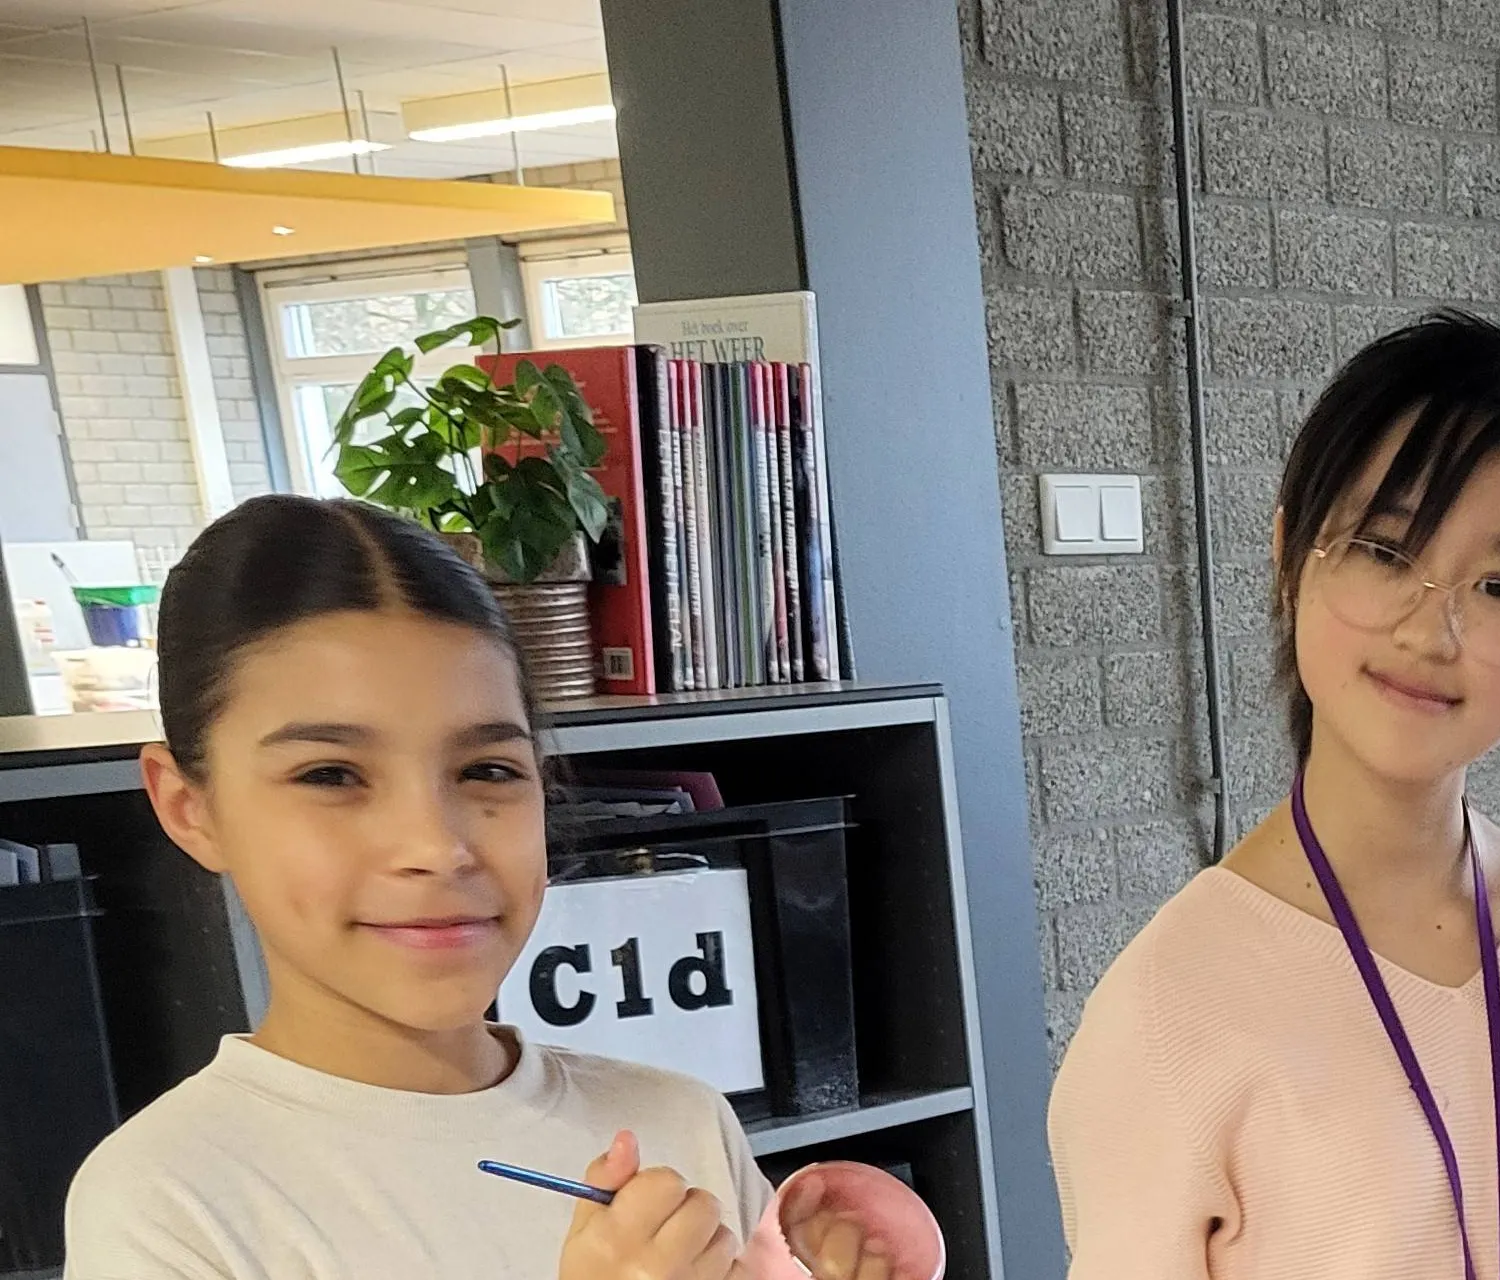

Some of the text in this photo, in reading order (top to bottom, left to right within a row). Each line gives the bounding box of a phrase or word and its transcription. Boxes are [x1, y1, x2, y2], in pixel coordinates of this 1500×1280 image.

[726, 320, 748, 334] over
[670, 336, 767, 361] HET WEER
[529, 930, 734, 1027] C1d
